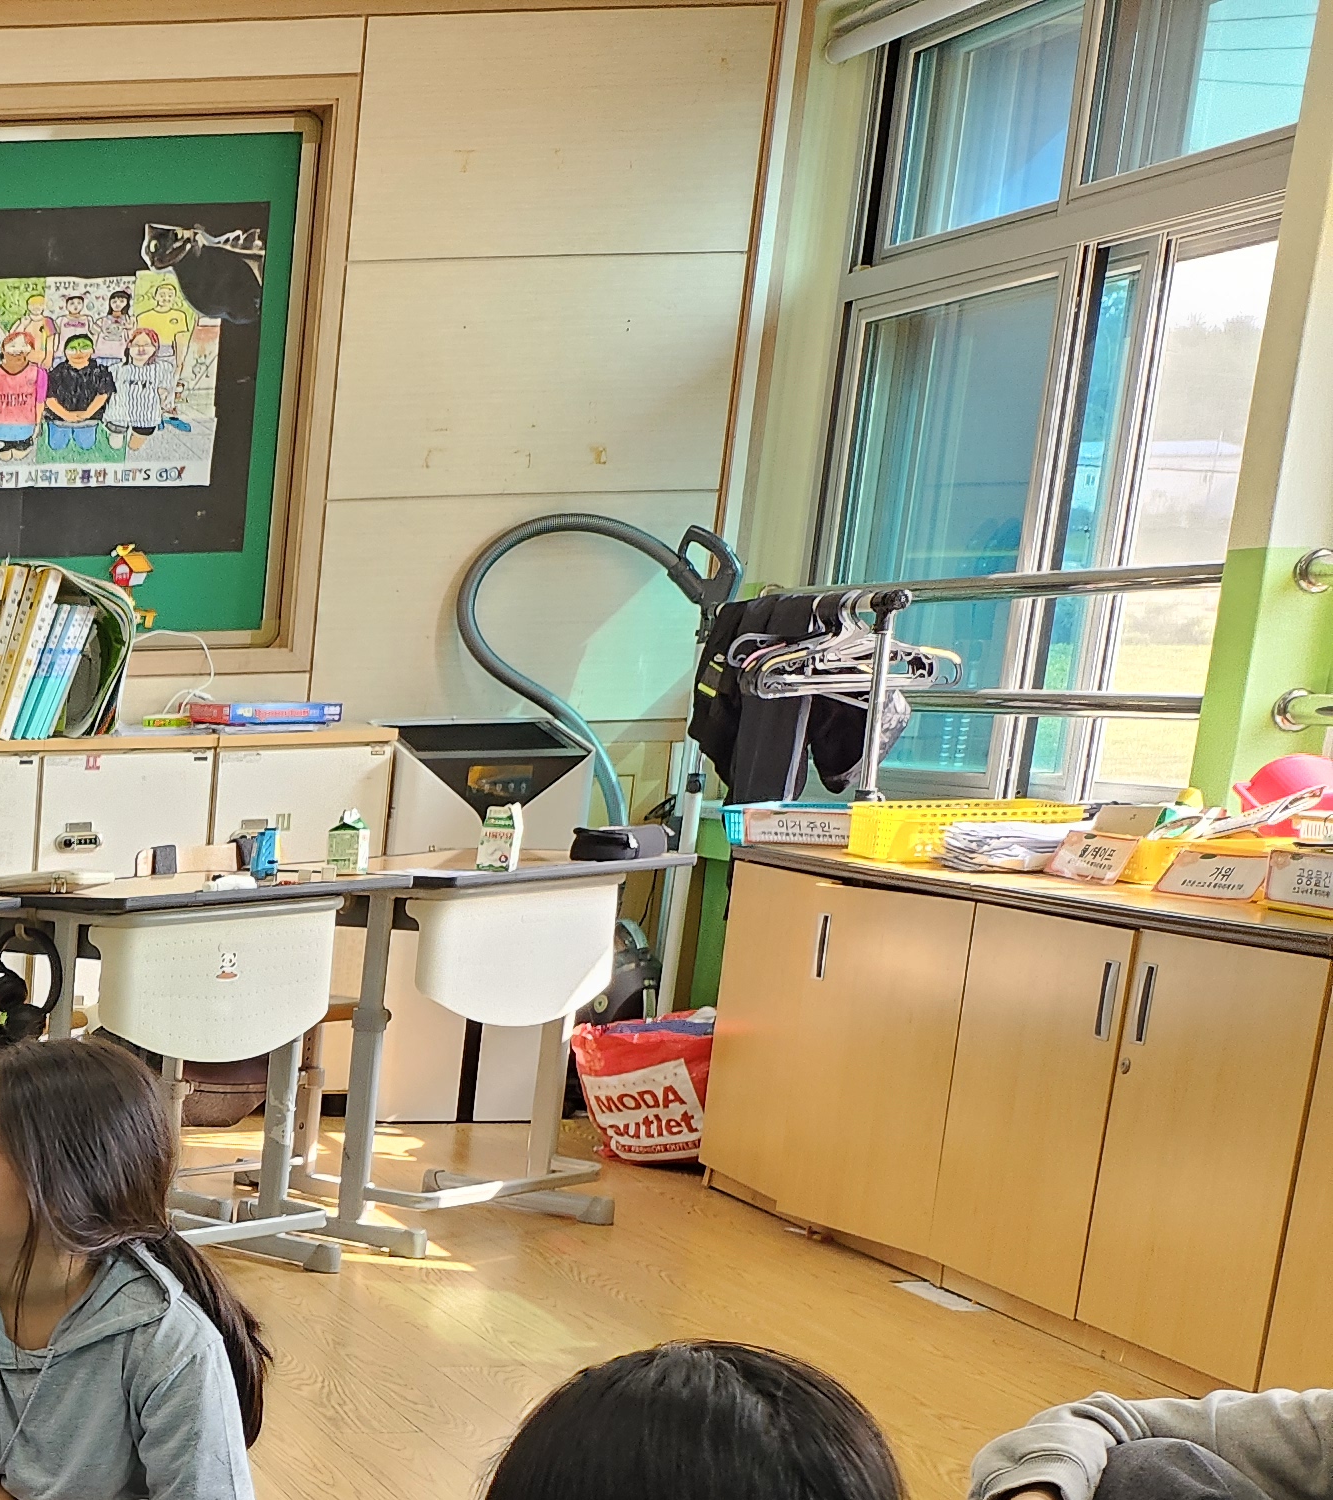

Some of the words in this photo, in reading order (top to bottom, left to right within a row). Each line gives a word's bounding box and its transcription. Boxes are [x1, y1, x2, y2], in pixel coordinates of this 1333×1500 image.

[777, 819, 803, 831] 이거
[1208, 865, 1236, 881] 가위
[594, 1084, 688, 1114] MODA
